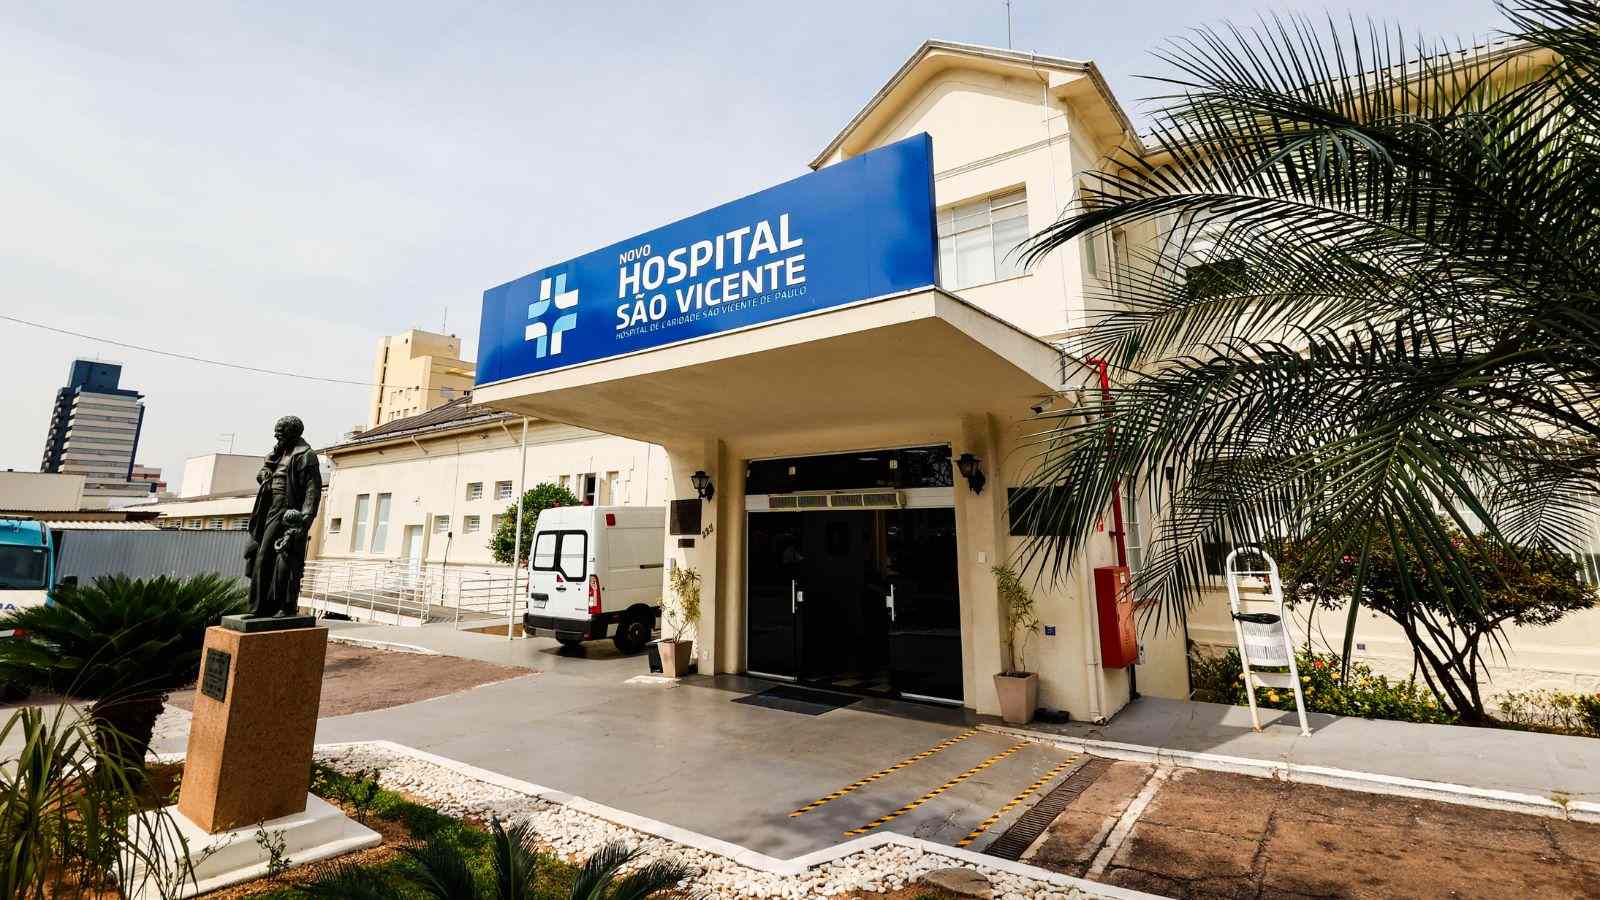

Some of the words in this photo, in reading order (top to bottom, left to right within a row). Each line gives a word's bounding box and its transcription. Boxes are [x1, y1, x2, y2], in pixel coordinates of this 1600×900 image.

[618, 212, 804, 298] HOSPITAL
[619, 244, 651, 265] NOVO
[615, 325, 649, 340] HOSPITAL
[650, 322, 659, 332] DE
[721, 298, 758, 314] VICENTE
[760, 294, 773, 305] DE
[774, 286, 807, 302] PAULO
[616, 292, 667, 330] SÃO
[675, 253, 806, 314] VICENTE
